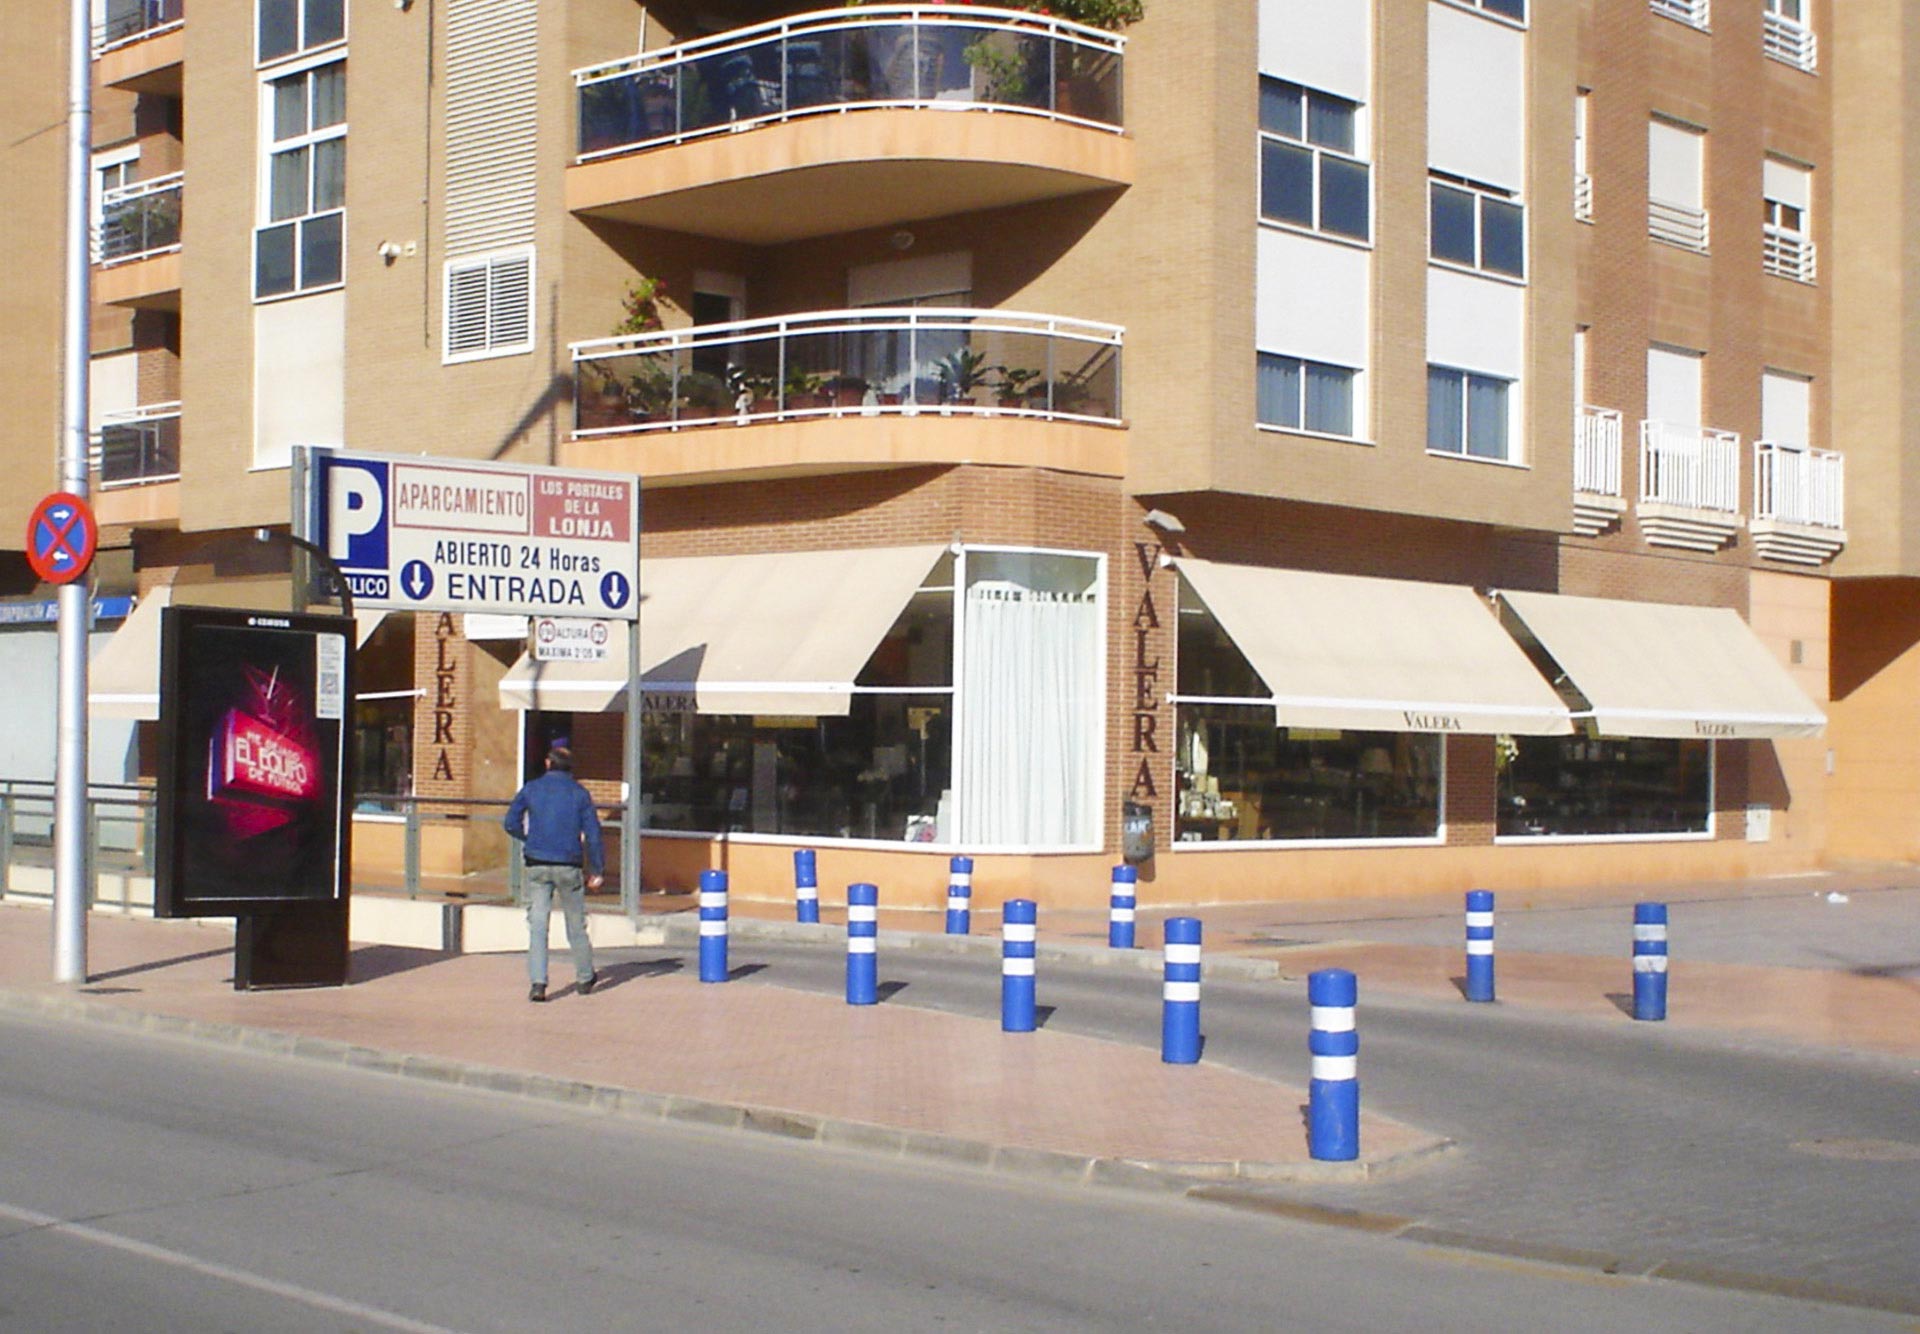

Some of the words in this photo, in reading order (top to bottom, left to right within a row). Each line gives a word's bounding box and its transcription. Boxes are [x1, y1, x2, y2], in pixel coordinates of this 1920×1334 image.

[399, 483, 525, 518] APARCAMIENTO
[541, 480, 563, 496] LOS
[567, 482, 623, 501] PORTALES
[328, 466, 384, 561] P
[564, 499, 580, 514] DE
[584, 501, 600, 516] LA
[549, 516, 614, 538] LONJA
[435, 540, 511, 568] ABIERTO
[520, 546, 541, 570] 24
[550, 547, 601, 573] Horas
[449, 573, 586, 606] ENTRADA
[1130, 542, 1161, 797] VALERA
[434, 611, 457, 781] ALERA
[641, 690, 699, 711] ALERA
[1403, 711, 1462, 730] VALERA
[235, 736, 257, 767] EL
[258, 746, 308, 784] EQUIPO
